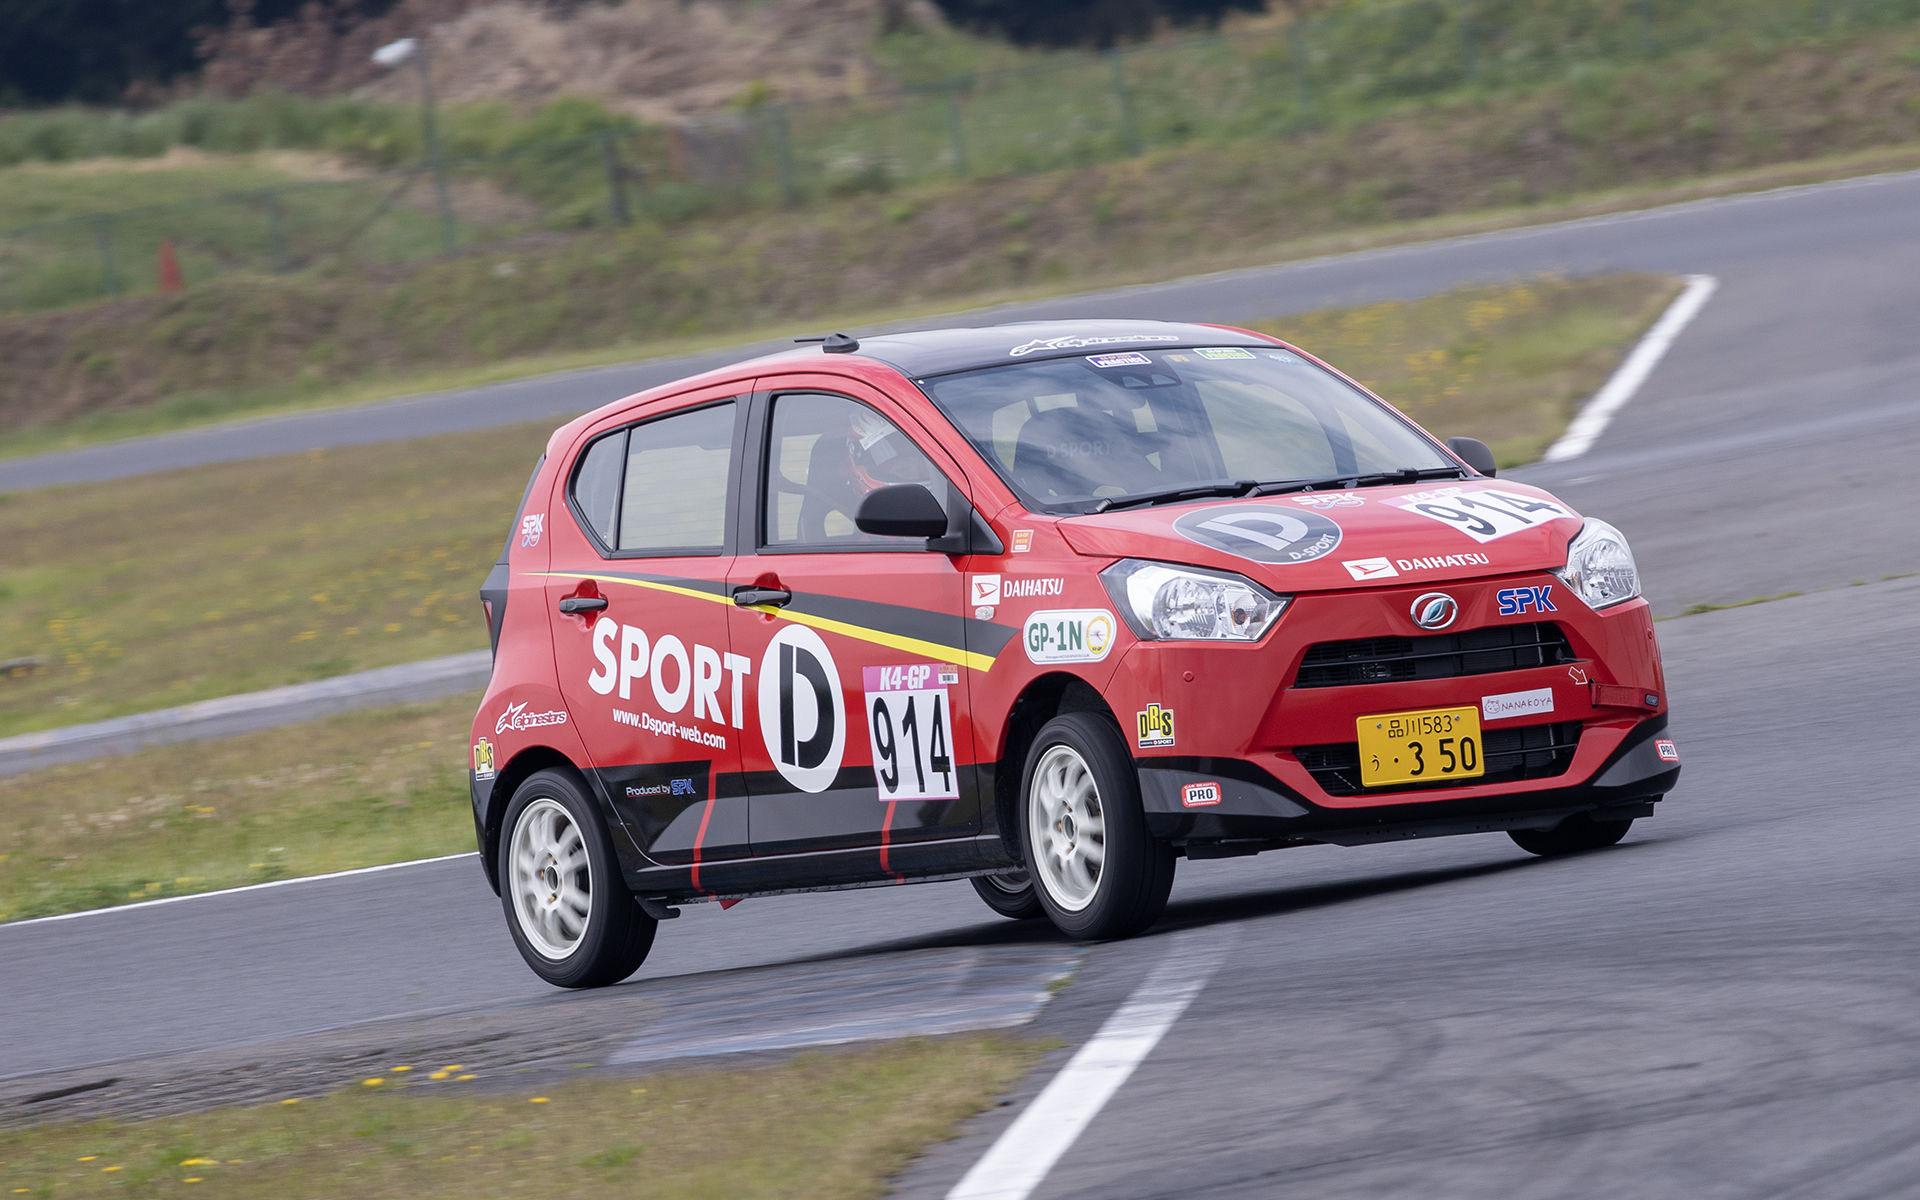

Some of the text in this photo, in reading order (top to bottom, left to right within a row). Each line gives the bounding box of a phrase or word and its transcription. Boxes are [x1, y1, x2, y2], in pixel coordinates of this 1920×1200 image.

[1291, 492, 1367, 506] SPK
[521, 513, 545, 535] SPK
[1414, 491, 1564, 536] 914
[1288, 533, 1336, 560] D-SPORT
[1396, 553, 1490, 571] DAIHATSU
[1003, 578, 1064, 598] DAIHATSU
[1496, 585, 1558, 616] SPK
[1028, 620, 1082, 653] GP-1N
[587, 617, 751, 731] SPORT
[879, 664, 931, 691] K4-GP
[1501, 697, 1552, 711] NANAKOYA
[514, 710, 567, 731] alpinestars
[612, 708, 727, 751] www.Dsport-web.com
[1140, 704, 1173, 739] DRS
[872, 694, 952, 794] 914
[625, 779, 696, 796] Produced by SPK
[1189, 788, 1214, 801] PRO
